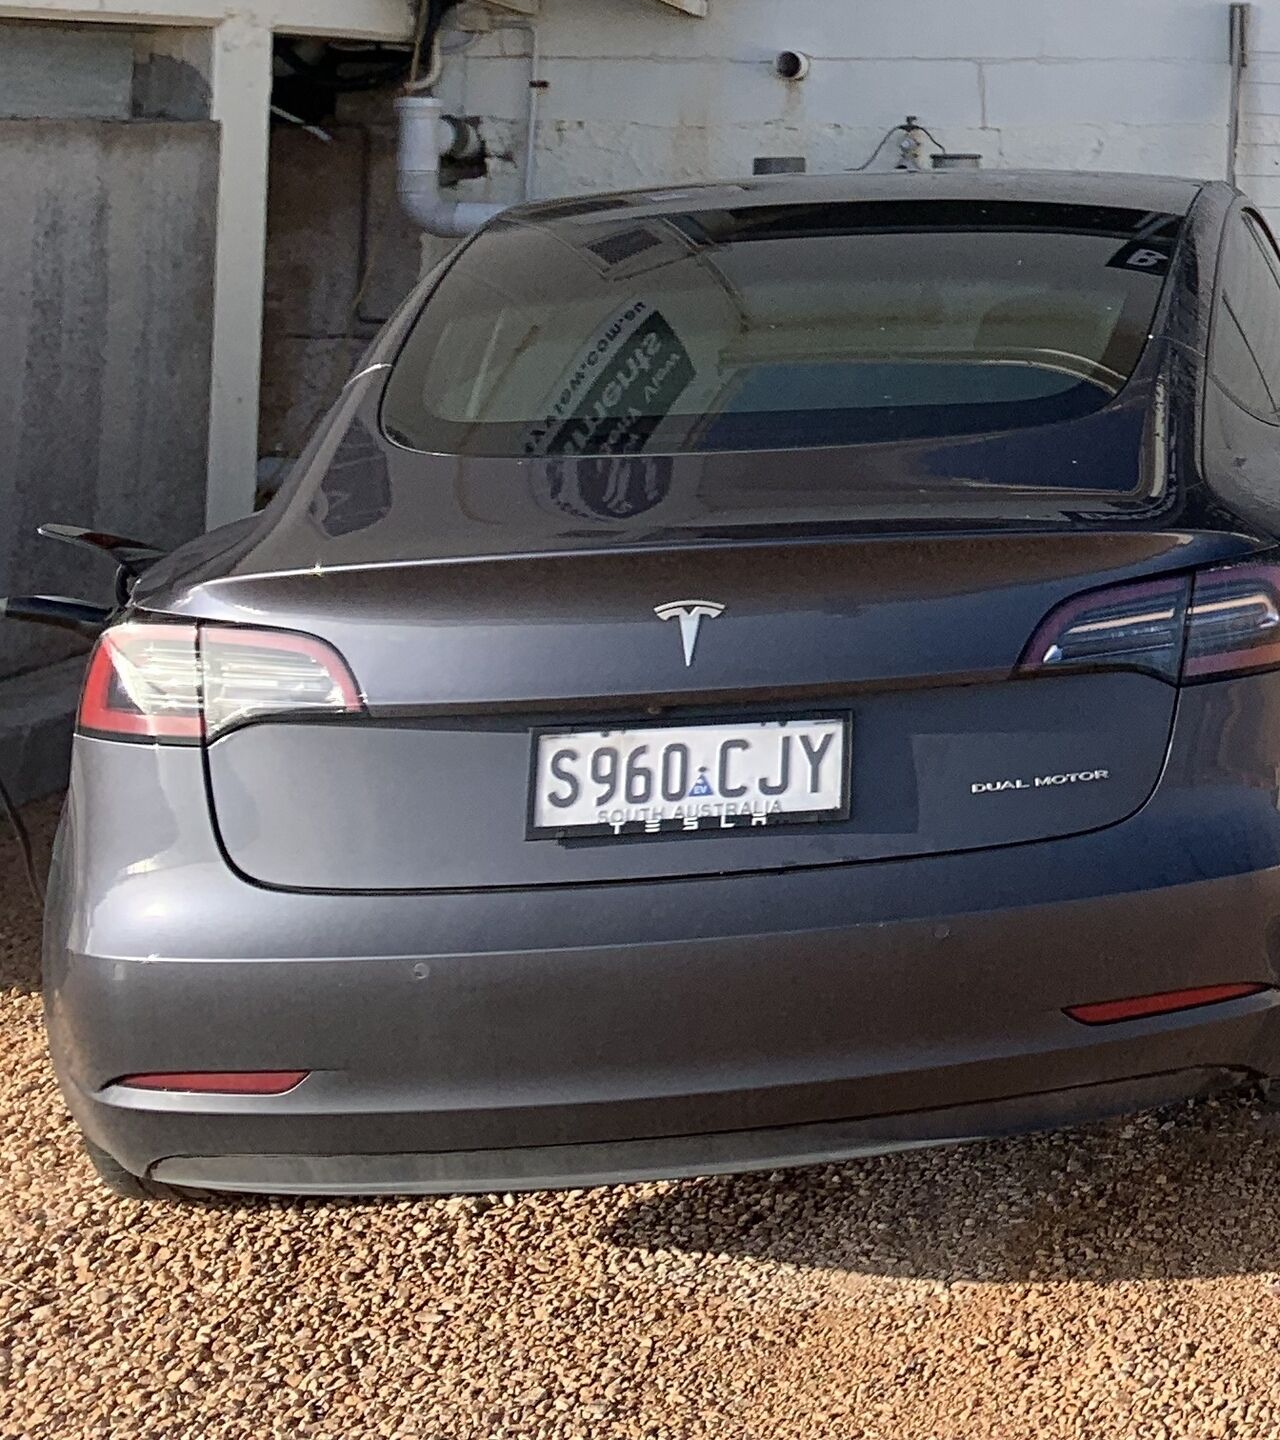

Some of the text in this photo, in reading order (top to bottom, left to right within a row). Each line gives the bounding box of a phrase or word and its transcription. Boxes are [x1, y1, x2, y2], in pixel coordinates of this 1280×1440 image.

[971, 769, 1110, 794] DUAL MOTOR
[597, 798, 783, 824] SOUTH AUSTRALIA
[609, 813, 767, 834] TESLA
